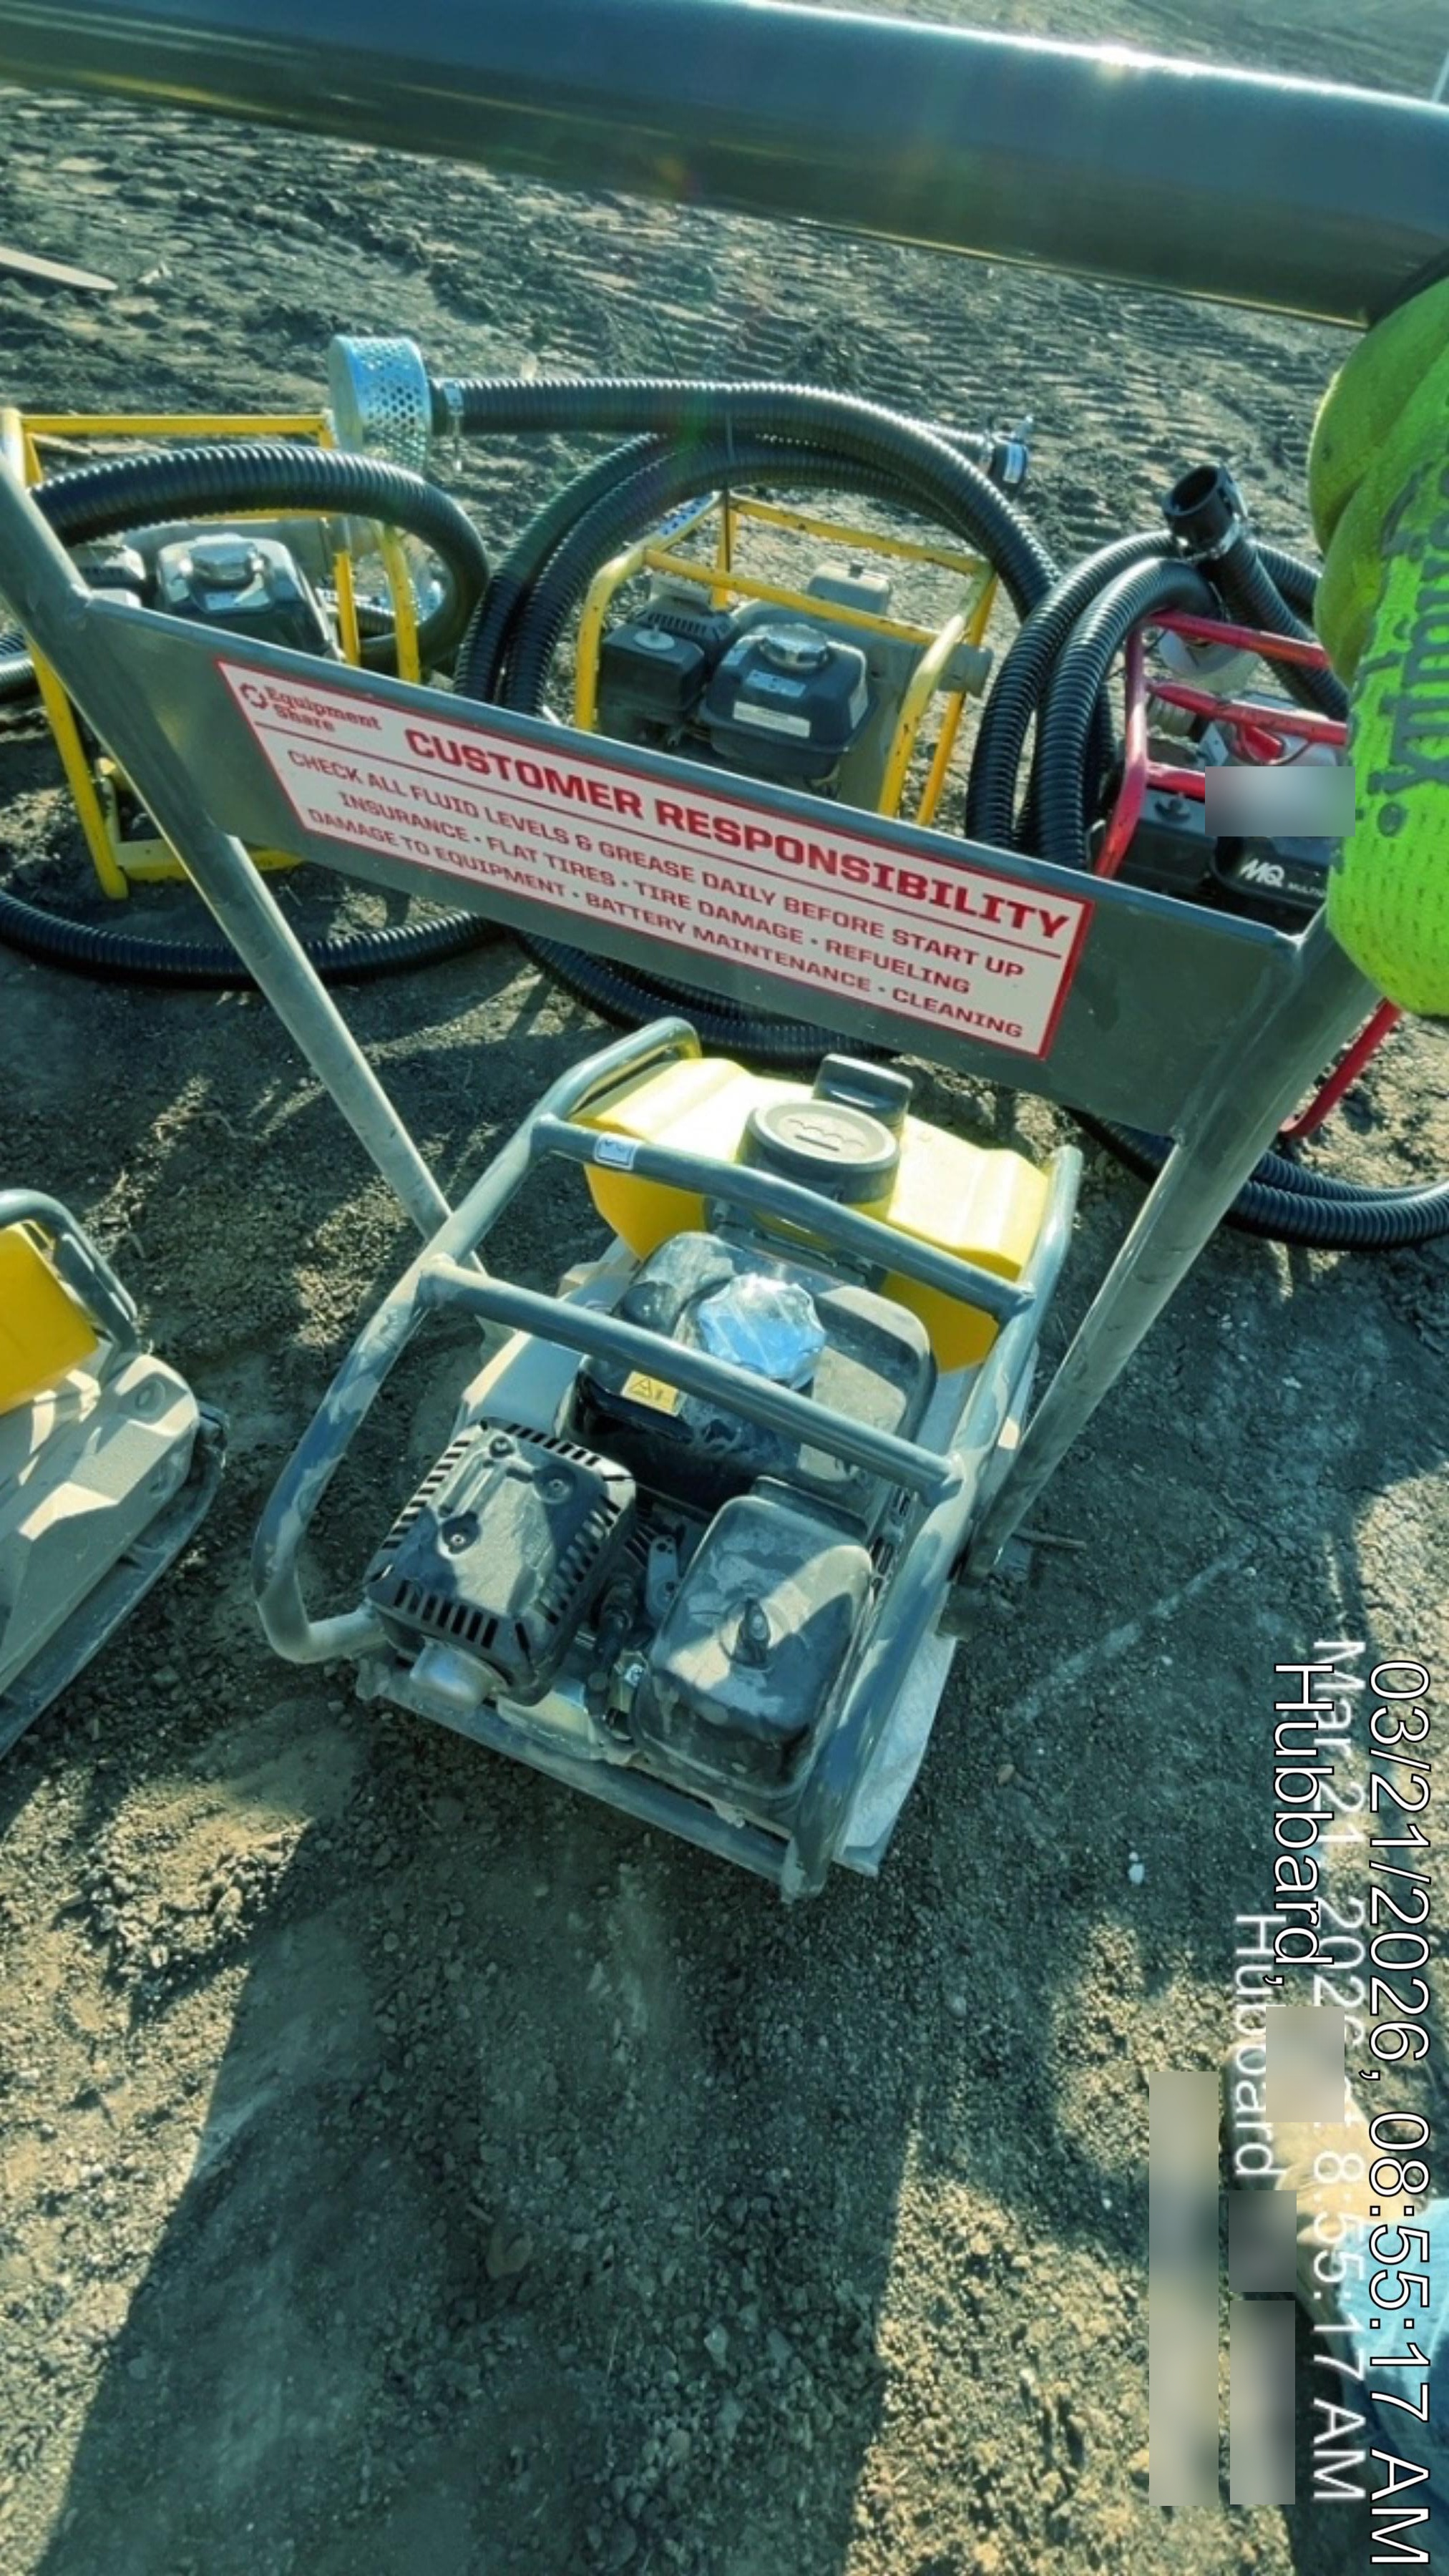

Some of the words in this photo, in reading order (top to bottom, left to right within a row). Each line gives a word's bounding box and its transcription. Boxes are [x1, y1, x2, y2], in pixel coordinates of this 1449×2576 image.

[263, 685, 382, 731] Equipment
[273, 702, 336, 732] Share
[288, 749, 364, 784] CHECK
[367, 771, 408, 798] ALL
[409, 784, 479, 819] FLUID
[484, 806, 570, 846] LEVELS
[574, 834, 592, 852] &
[597, 840, 696, 884] GREASE
[701, 871, 776, 907] DAILY
[783, 895, 885, 940] BEFORE
[892, 928, 980, 966] START
[985, 956, 1025, 978] UP
[308, 808, 399, 847] DAMAGE
[399, 834, 430, 856] TO
[434, 846, 566, 897] EQUIPMENT
[585, 892, 686, 935] BATTERY
[692, 924, 872, 992] MAINTENANCE
[892, 987, 1023, 1038] CLEANING
[338, 791, 471, 843] INSURANCE
[486, 836, 538, 864] FLAT
[544, 852, 616, 887] TIRES
[632, 879, 693, 911] TIRE
[697, 899, 804, 945] DAMAGE
[824, 938, 971, 995] REFUELING
[405, 728, 643, 819] CUSTOMER
[654, 799, 1070, 939] RESPONSIBILITY
[1239, 858, 1285, 887] MQ
